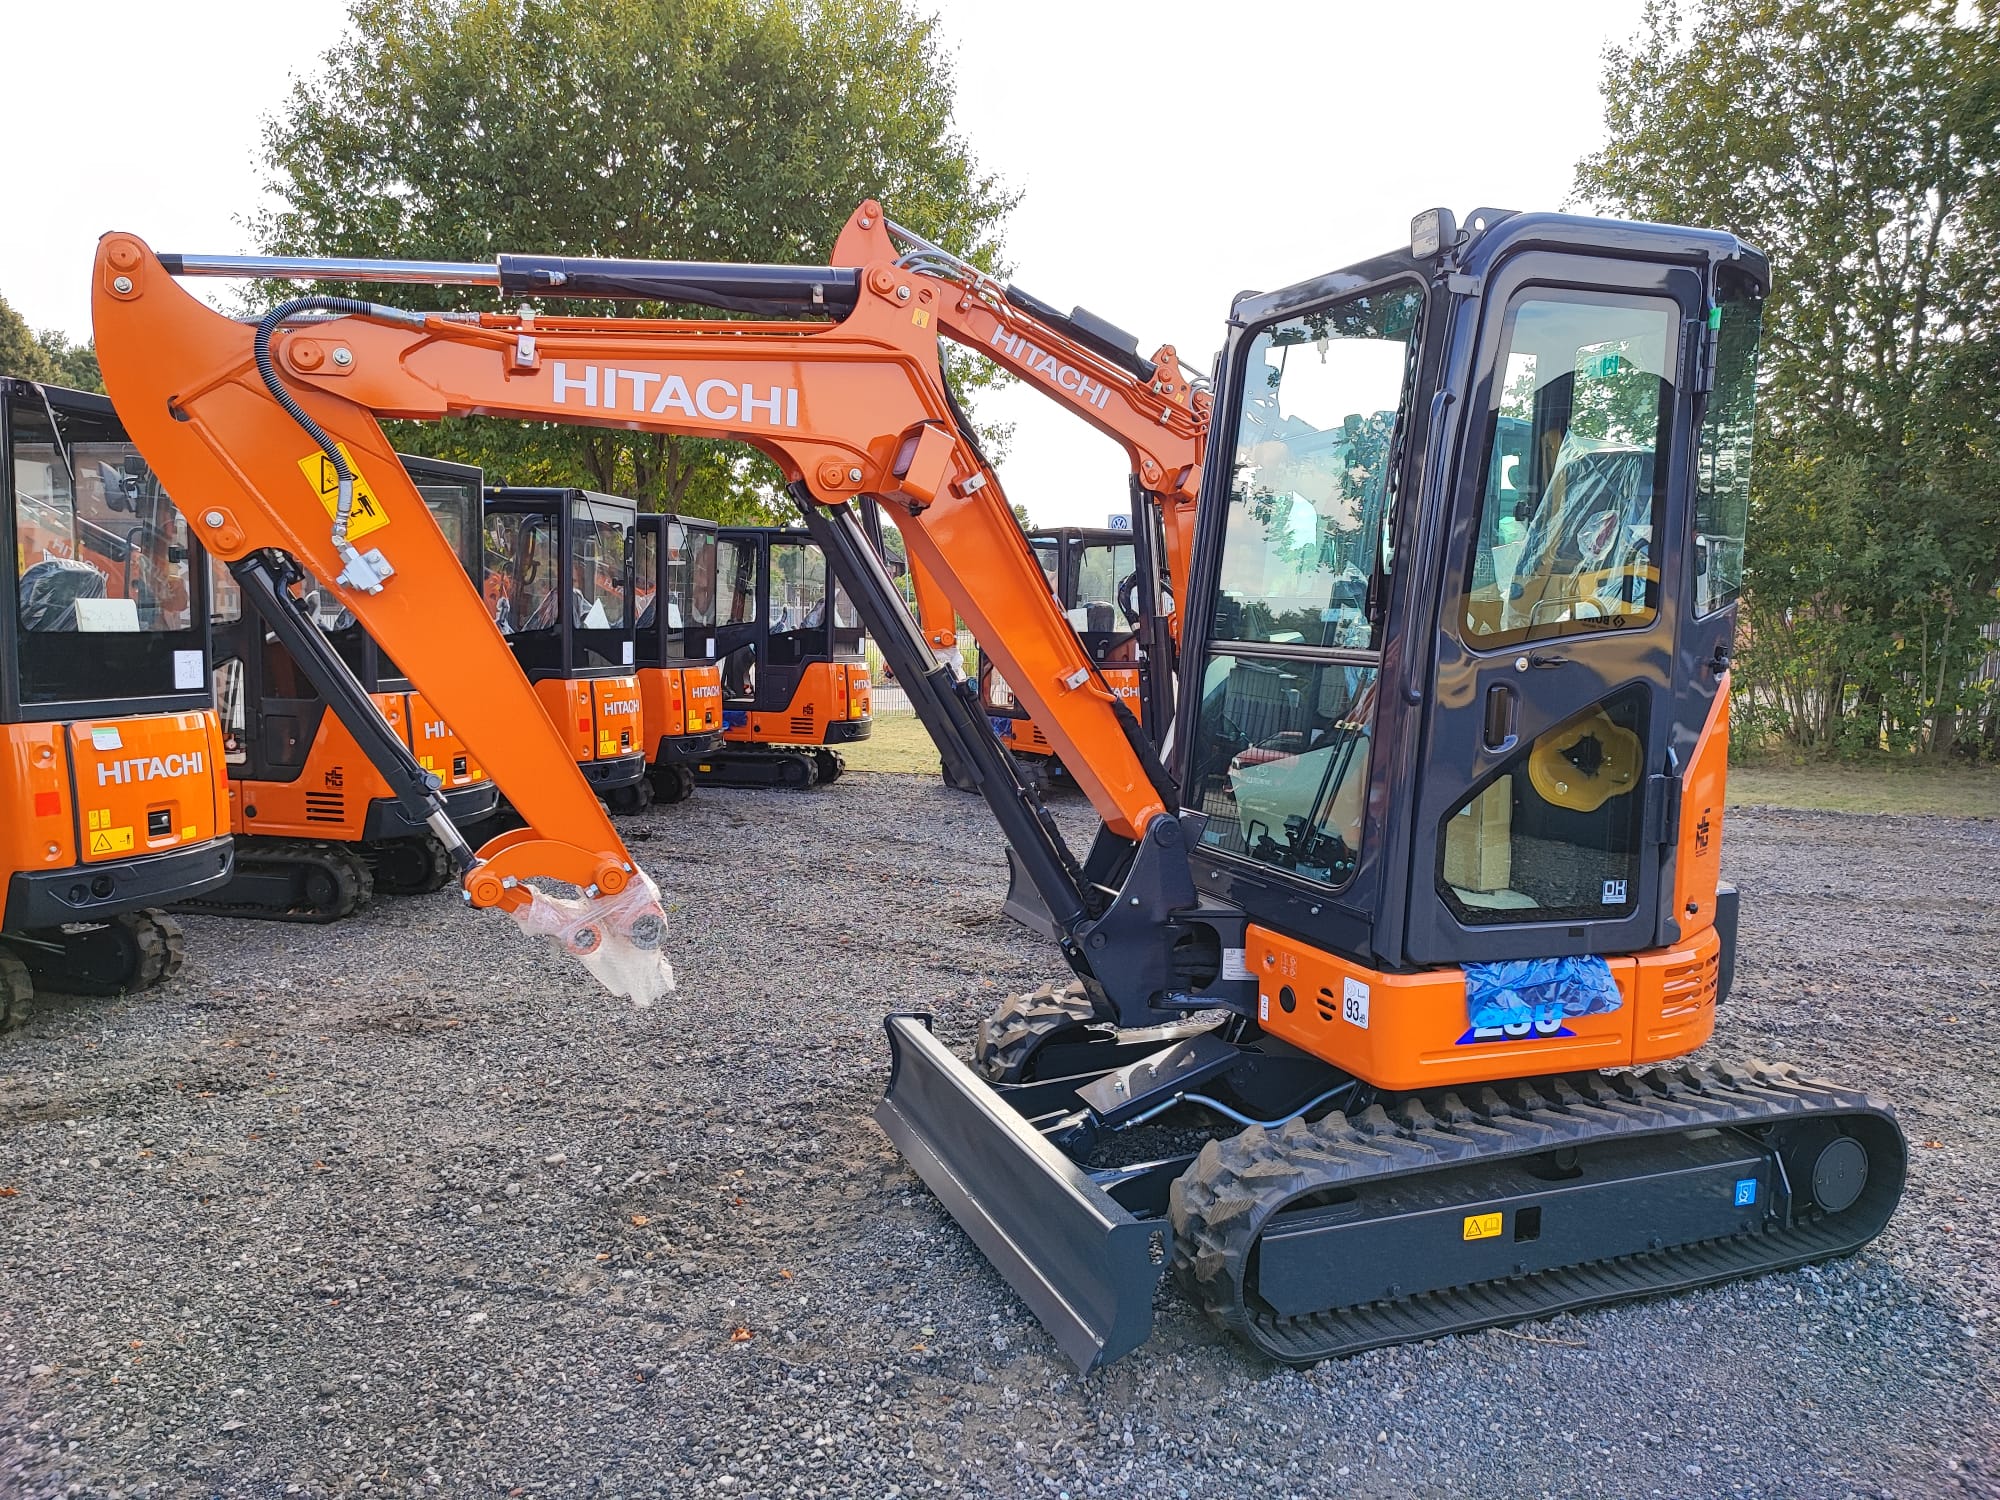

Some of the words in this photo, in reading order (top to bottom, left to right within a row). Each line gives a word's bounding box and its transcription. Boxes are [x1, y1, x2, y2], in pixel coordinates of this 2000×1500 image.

[990, 324, 1111, 409] HITACHI
[552, 362, 799, 427] HITACHI
[604, 699, 640, 716] HITACHI
[97, 751, 204, 786] HITACHI
[1346, 997, 1360, 1021] 93
